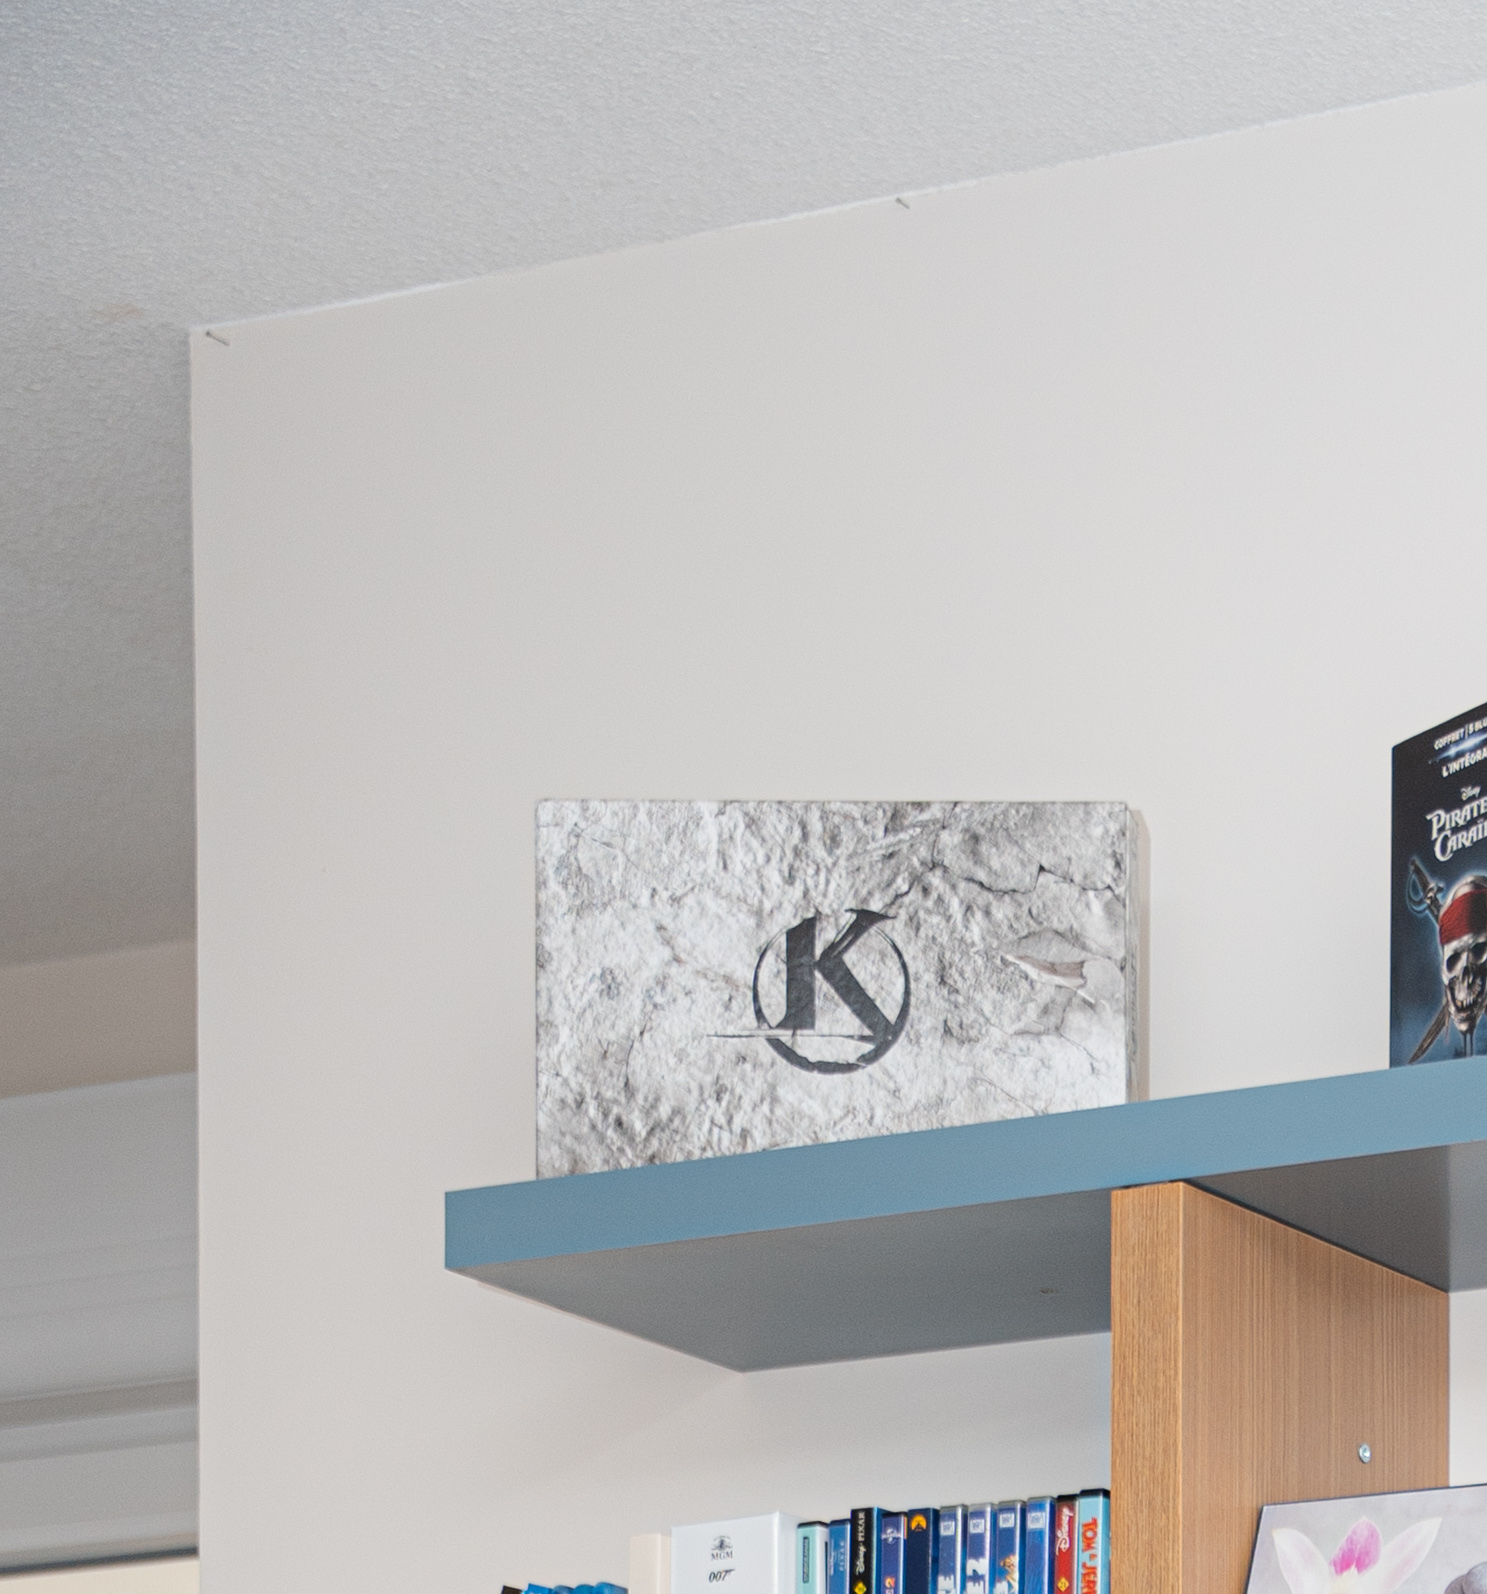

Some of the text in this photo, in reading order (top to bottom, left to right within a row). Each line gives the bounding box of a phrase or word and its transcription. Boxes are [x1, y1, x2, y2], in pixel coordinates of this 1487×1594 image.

[1461, 785, 1480, 800] Disney
[1055, 1506, 1073, 1556] Disney
[1082, 1518, 1098, 1552] TOM
[710, 1550, 734, 1561] MGM
[708, 1568, 735, 1583] 007
